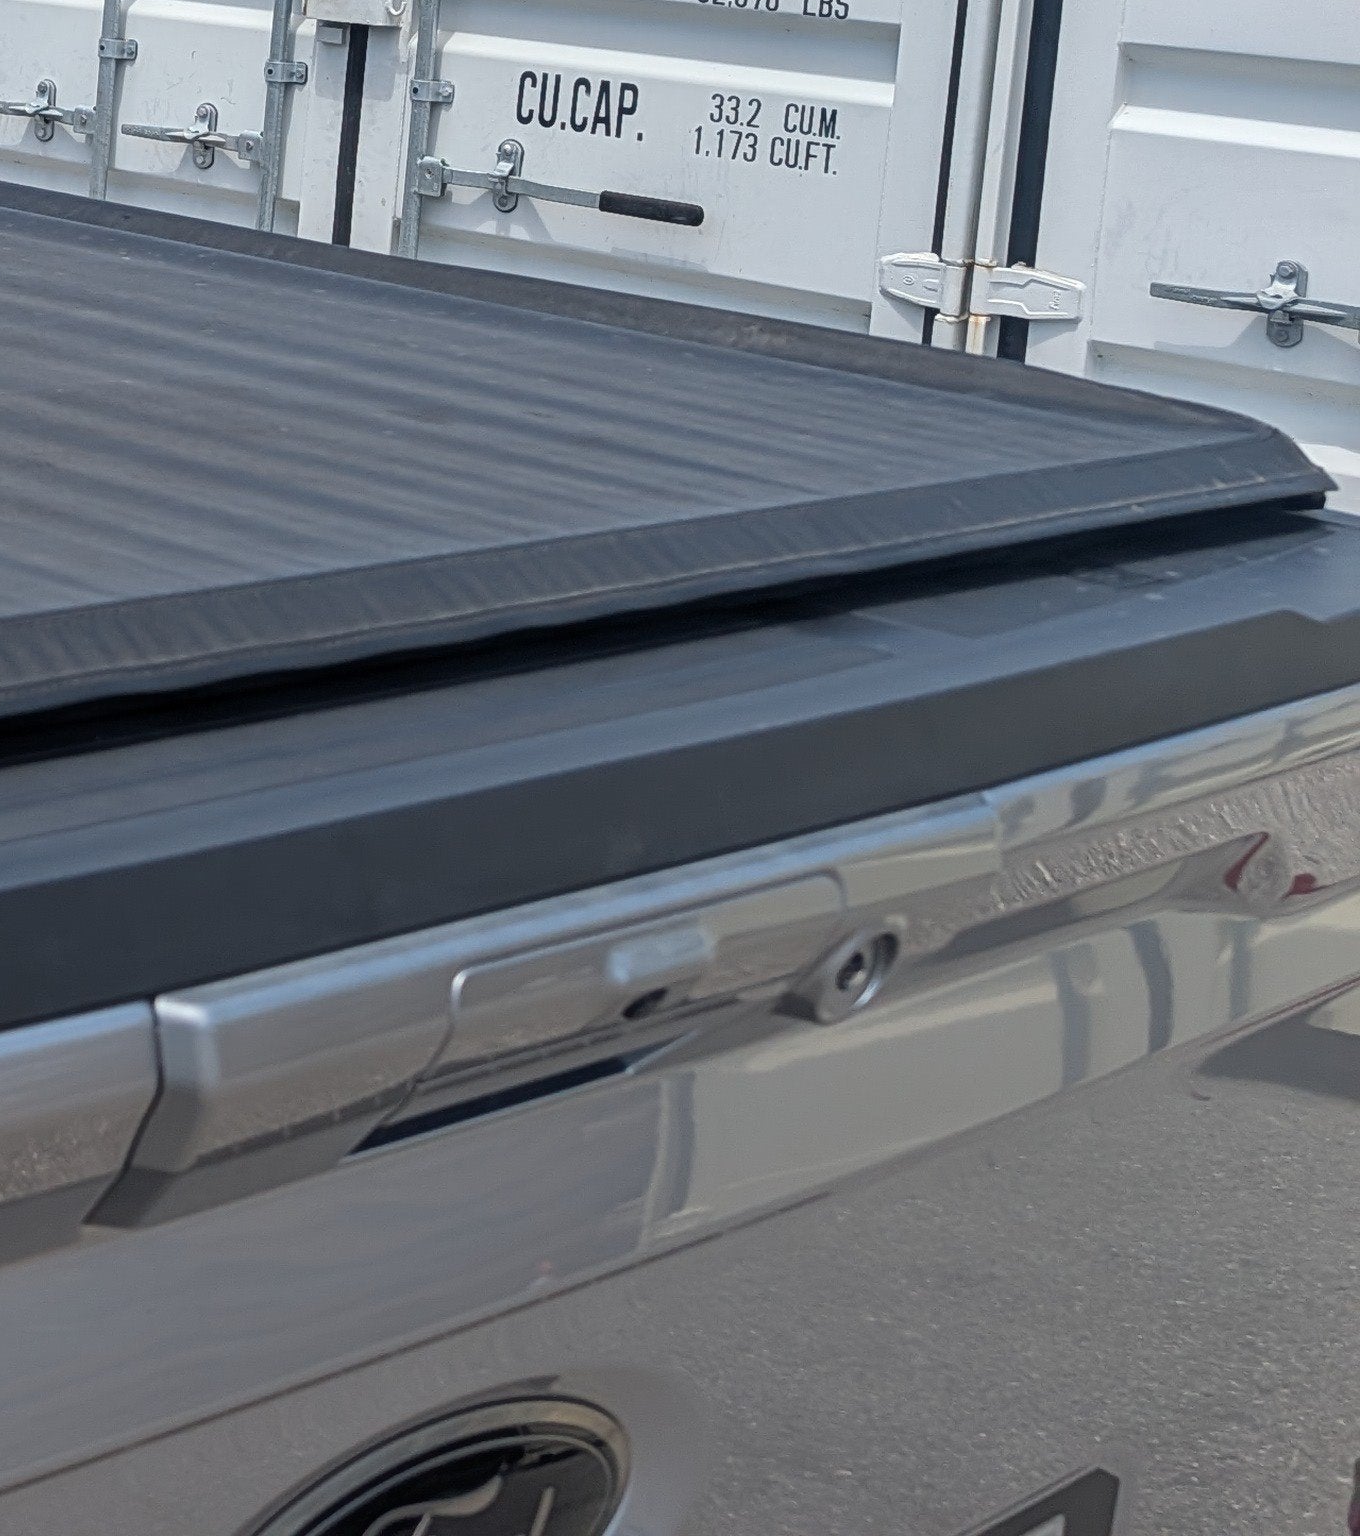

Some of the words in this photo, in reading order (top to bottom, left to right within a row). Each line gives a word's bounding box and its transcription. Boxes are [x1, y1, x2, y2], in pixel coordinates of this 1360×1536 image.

[709, 93, 762, 128] 33.2
[783, 102, 842, 140] CU.M.
[769, 136, 838, 176] CU.FT.
